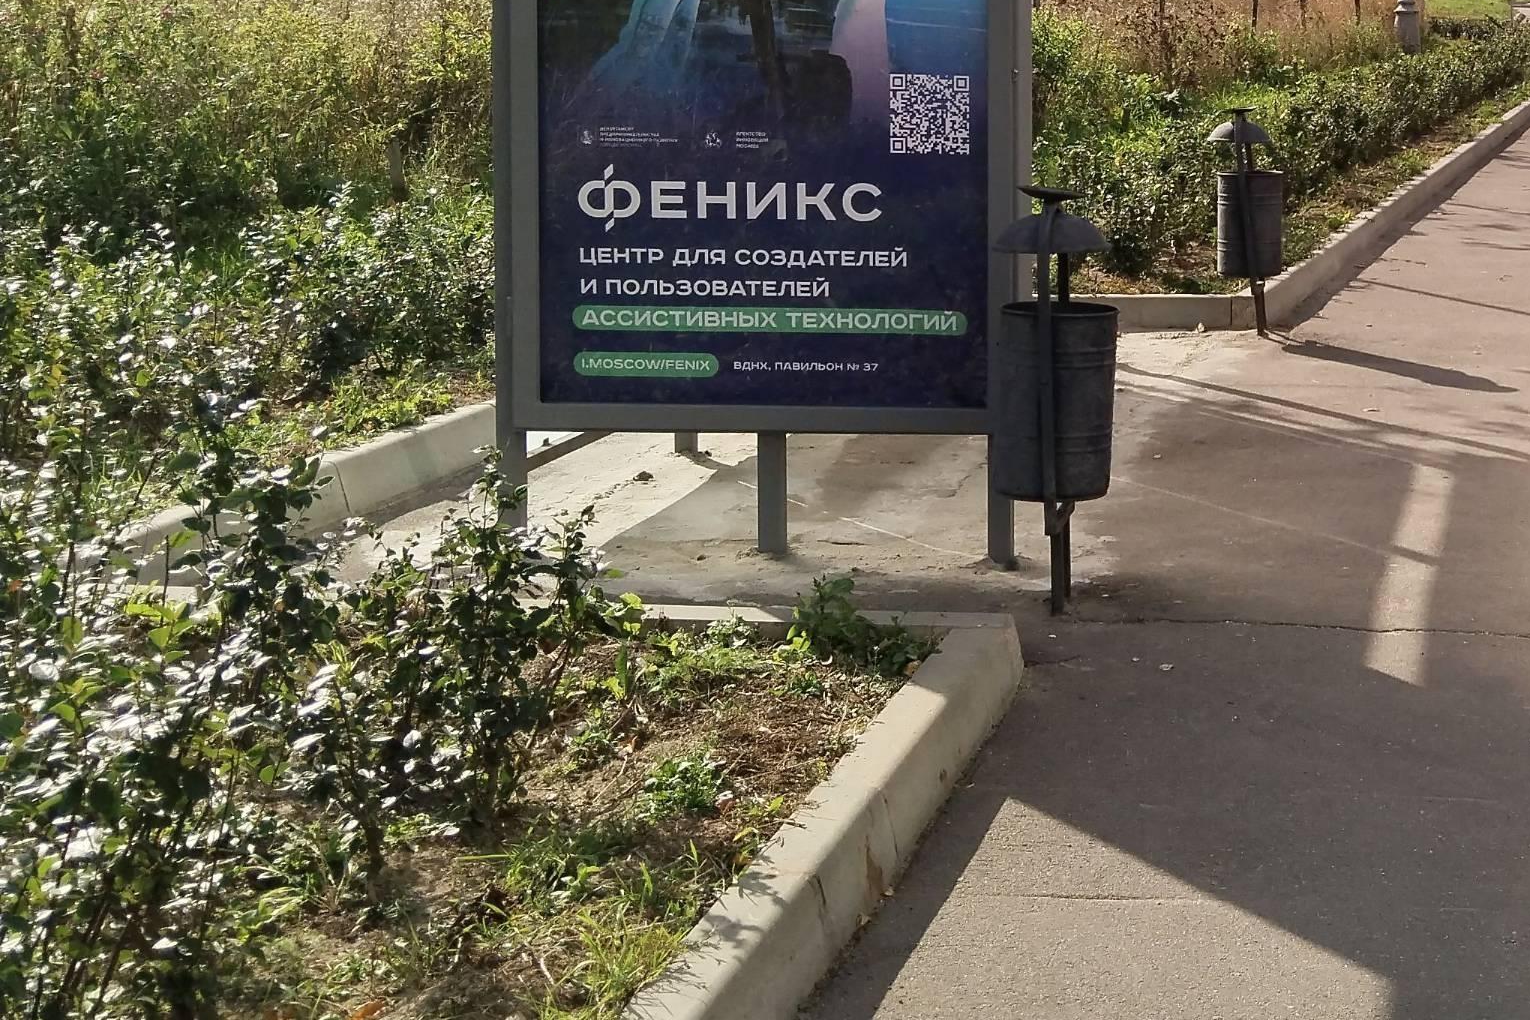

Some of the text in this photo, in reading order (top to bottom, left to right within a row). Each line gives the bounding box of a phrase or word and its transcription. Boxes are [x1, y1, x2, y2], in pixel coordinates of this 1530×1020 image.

[578, 163, 883, 232] ФЕНИКС
[579, 246, 908, 269] ЦЕНТР ДЛЯ СОЗДАТЕЛЕЙ
[580, 278, 830, 298] И ПОЛЬЗОВАТЕЛЕЙ
[582, 310, 958, 332] АССИСТИВНЫХ ТЕХНОЛОГИЙ
[582, 358, 710, 372] I.MOSCOW/FENIX
[733, 360, 879, 372] ВДНХ, ПАВИЛЬОН № 37
